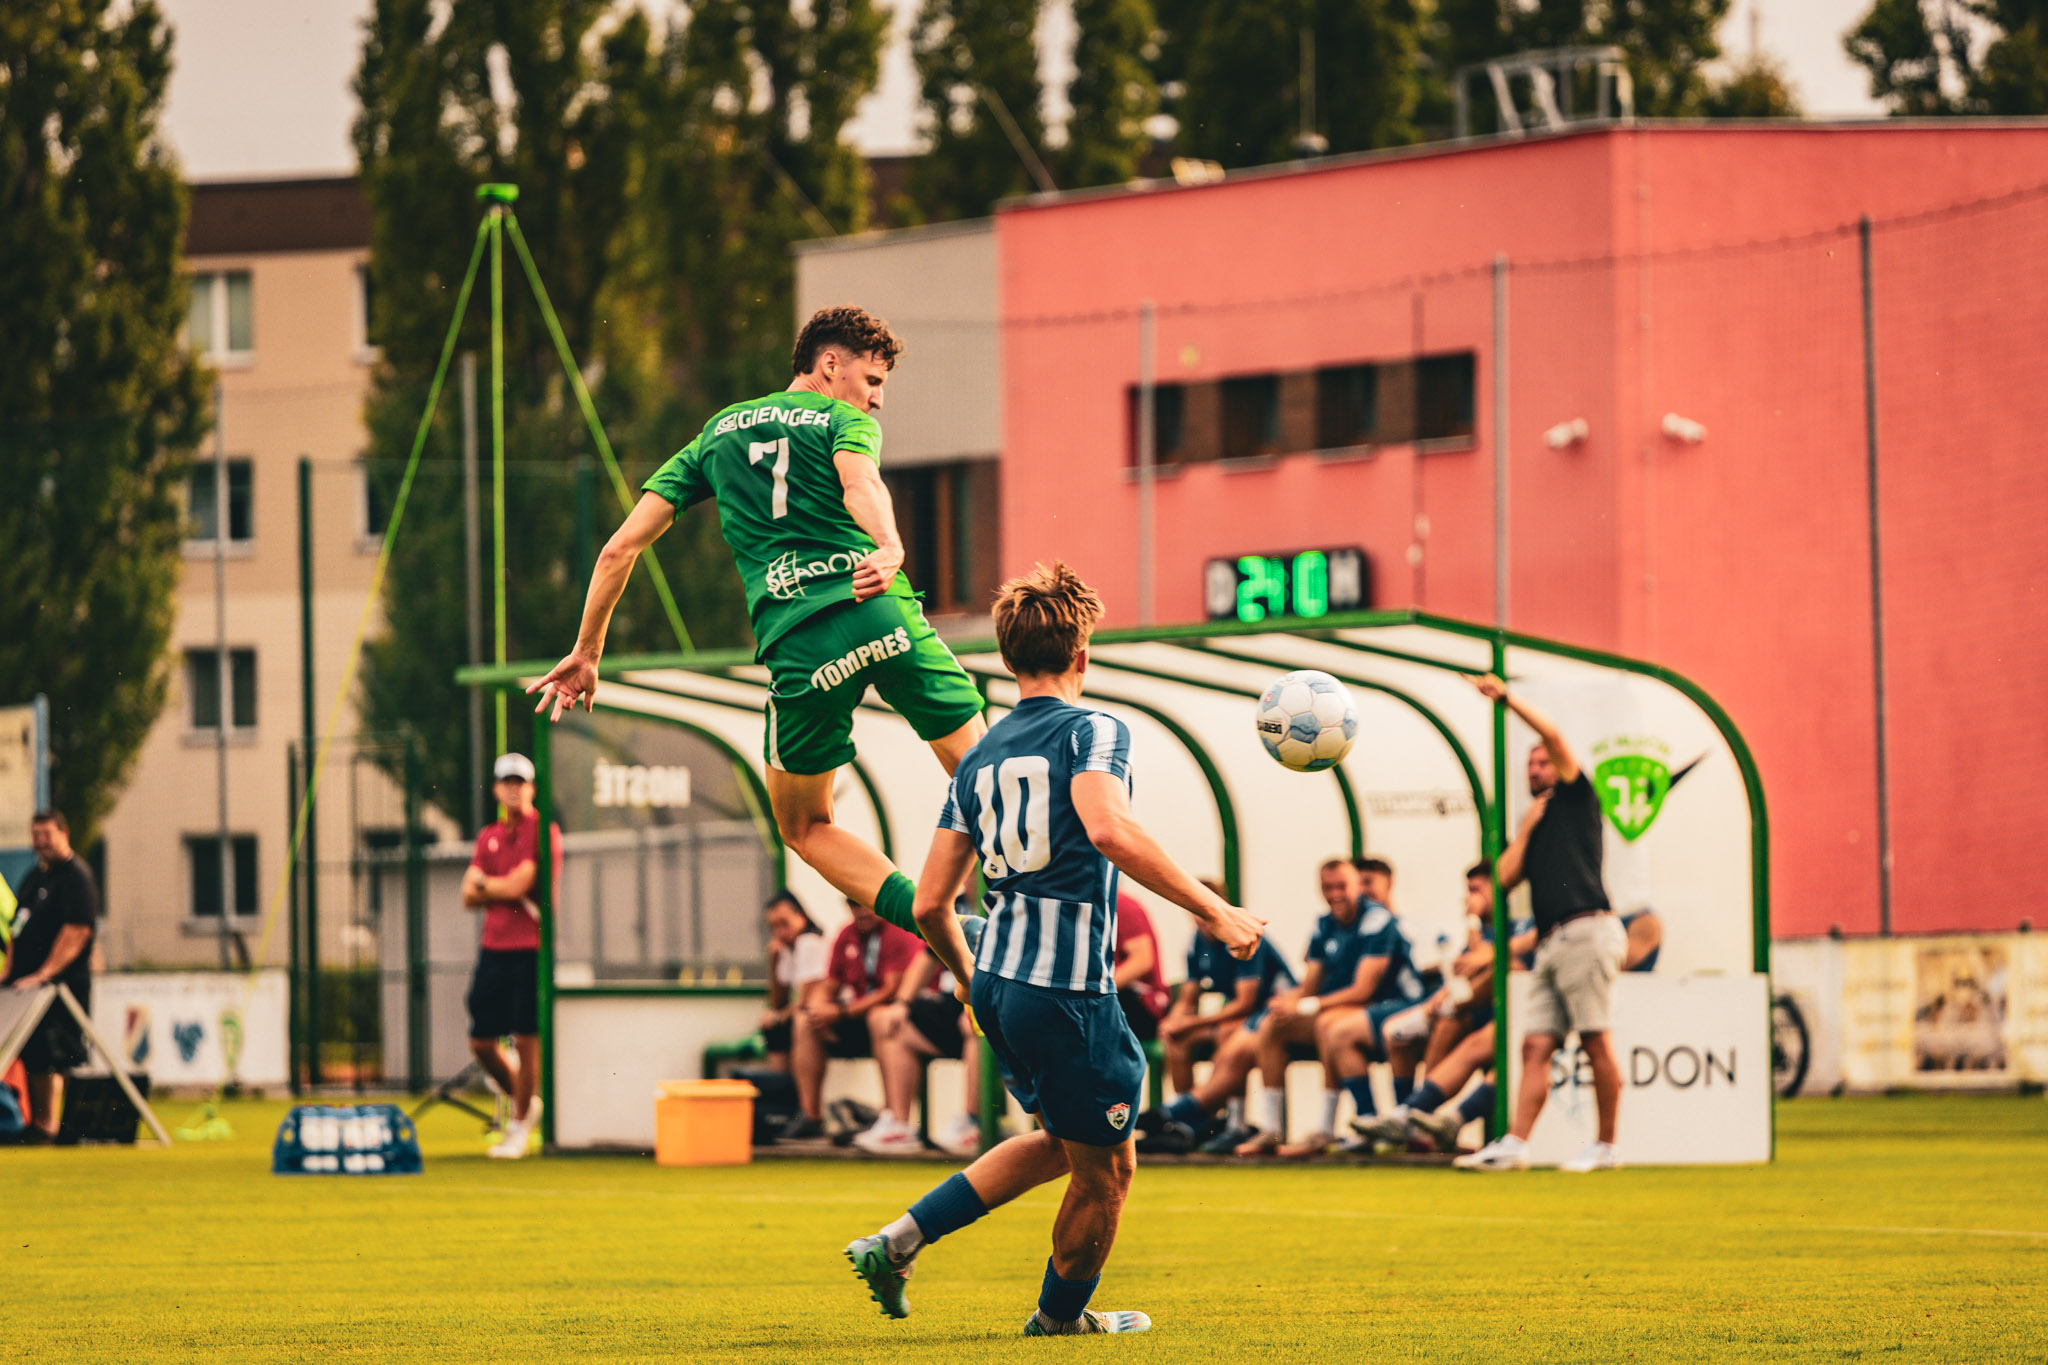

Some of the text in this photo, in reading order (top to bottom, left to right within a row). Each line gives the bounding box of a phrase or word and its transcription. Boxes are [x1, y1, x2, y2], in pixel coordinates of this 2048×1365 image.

[737, 406, 831, 430] GIENGER
[748, 437, 790, 520] 7
[974, 755, 1052, 879] 10
[1552, 1045, 1737, 1090] SEDON
